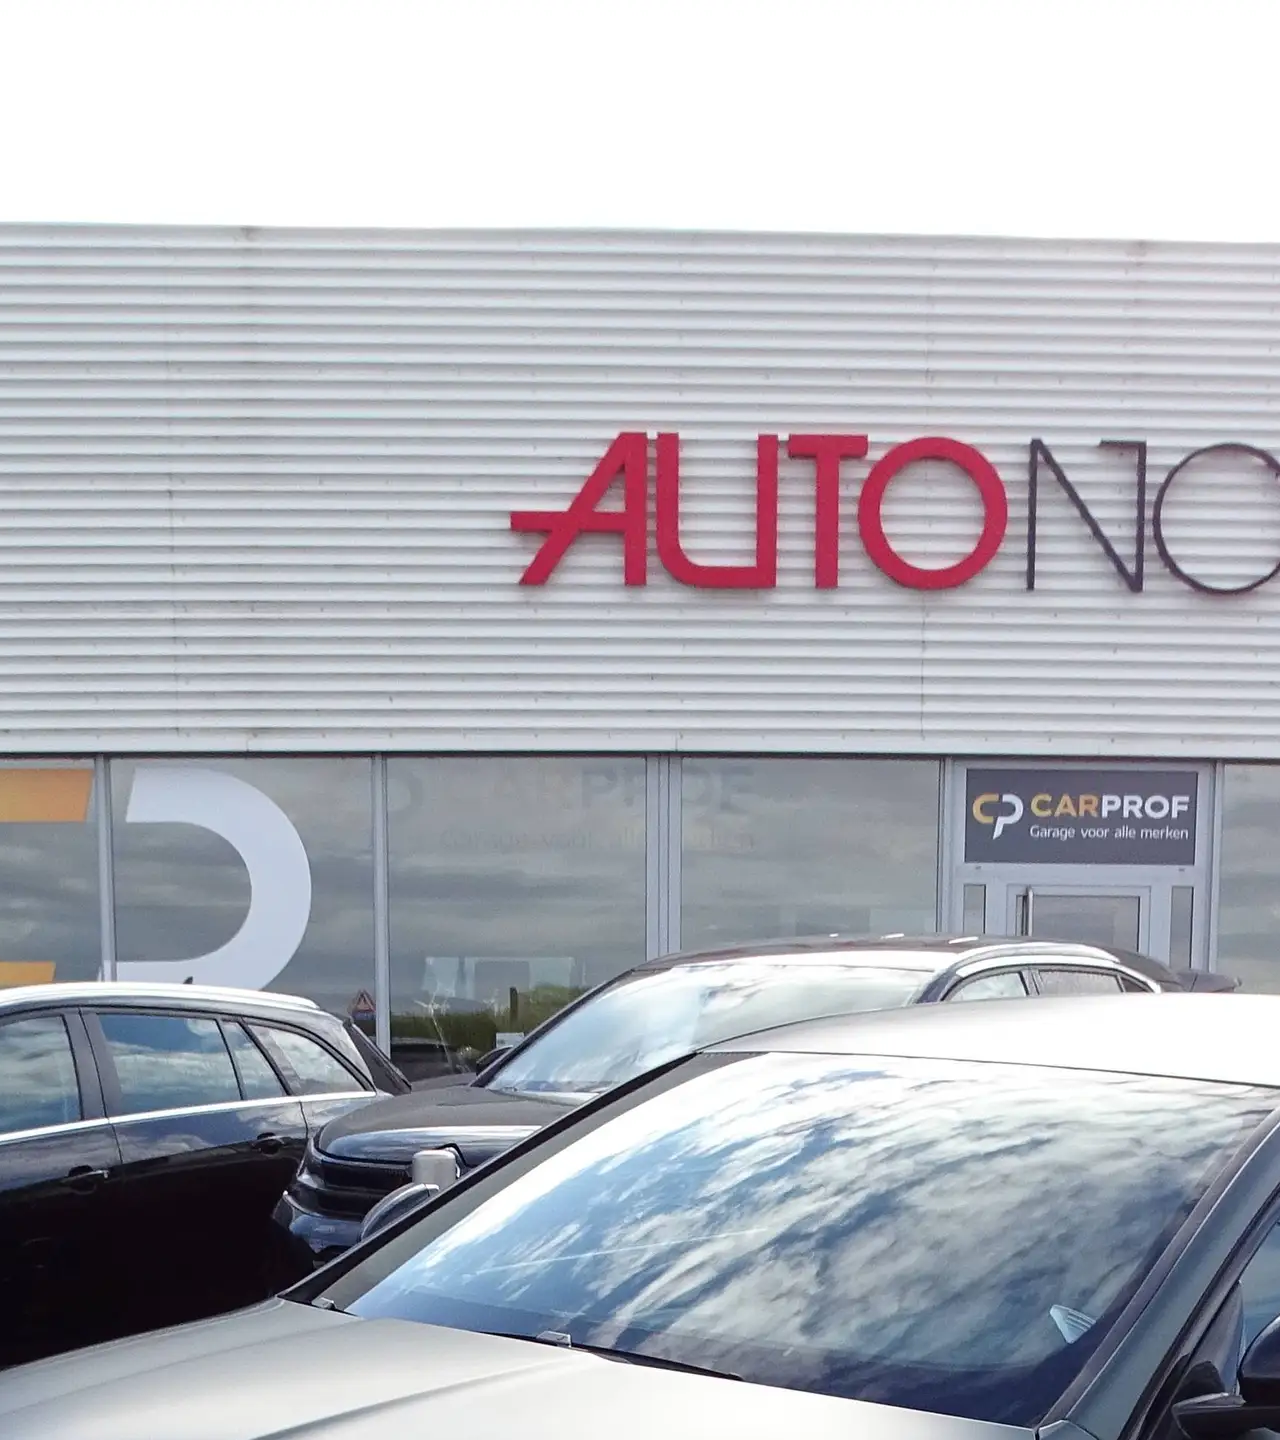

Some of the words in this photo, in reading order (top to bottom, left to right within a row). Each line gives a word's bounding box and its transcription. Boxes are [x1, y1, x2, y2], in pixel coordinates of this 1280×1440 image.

[1030, 793, 1190, 820] CARPROF
[1029, 825, 1076, 842] Garage
[1080, 827, 1109, 839] voor
[1114, 826, 1136, 839] alle
[1140, 827, 1189, 841] merken
